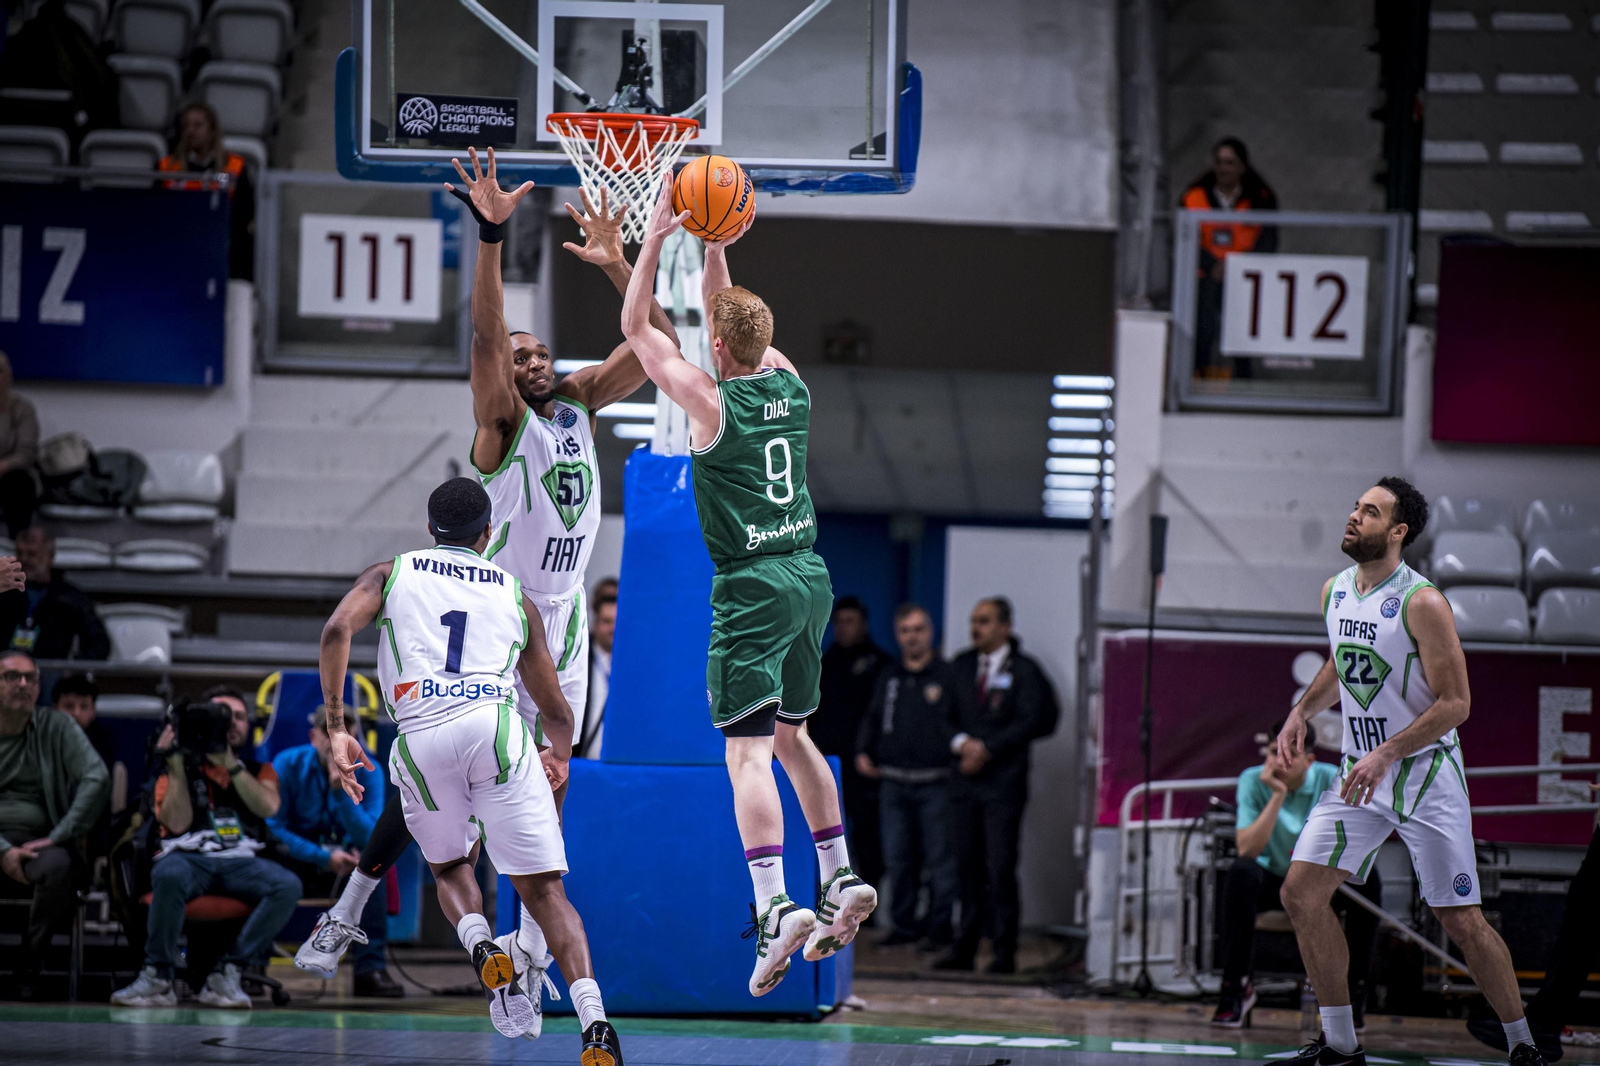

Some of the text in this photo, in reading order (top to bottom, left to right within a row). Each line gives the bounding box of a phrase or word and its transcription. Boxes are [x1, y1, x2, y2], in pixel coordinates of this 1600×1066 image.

[440, 103, 507, 116] BASKETBALL
[440, 113, 515, 127] CHAMPIONS
[440, 123, 480, 134] LEAGUE
[325, 231, 414, 303] 111
[1243, 270, 1349, 341] 112
[763, 397, 790, 421] DÍAZ
[764, 437, 794, 505] 9
[541, 534, 586, 573] FIAT
[412, 557, 504, 587] WINSTON
[440, 609, 468, 675] 1
[1342, 651, 1379, 685] 22
[1348, 716, 1388, 752] FIAT
